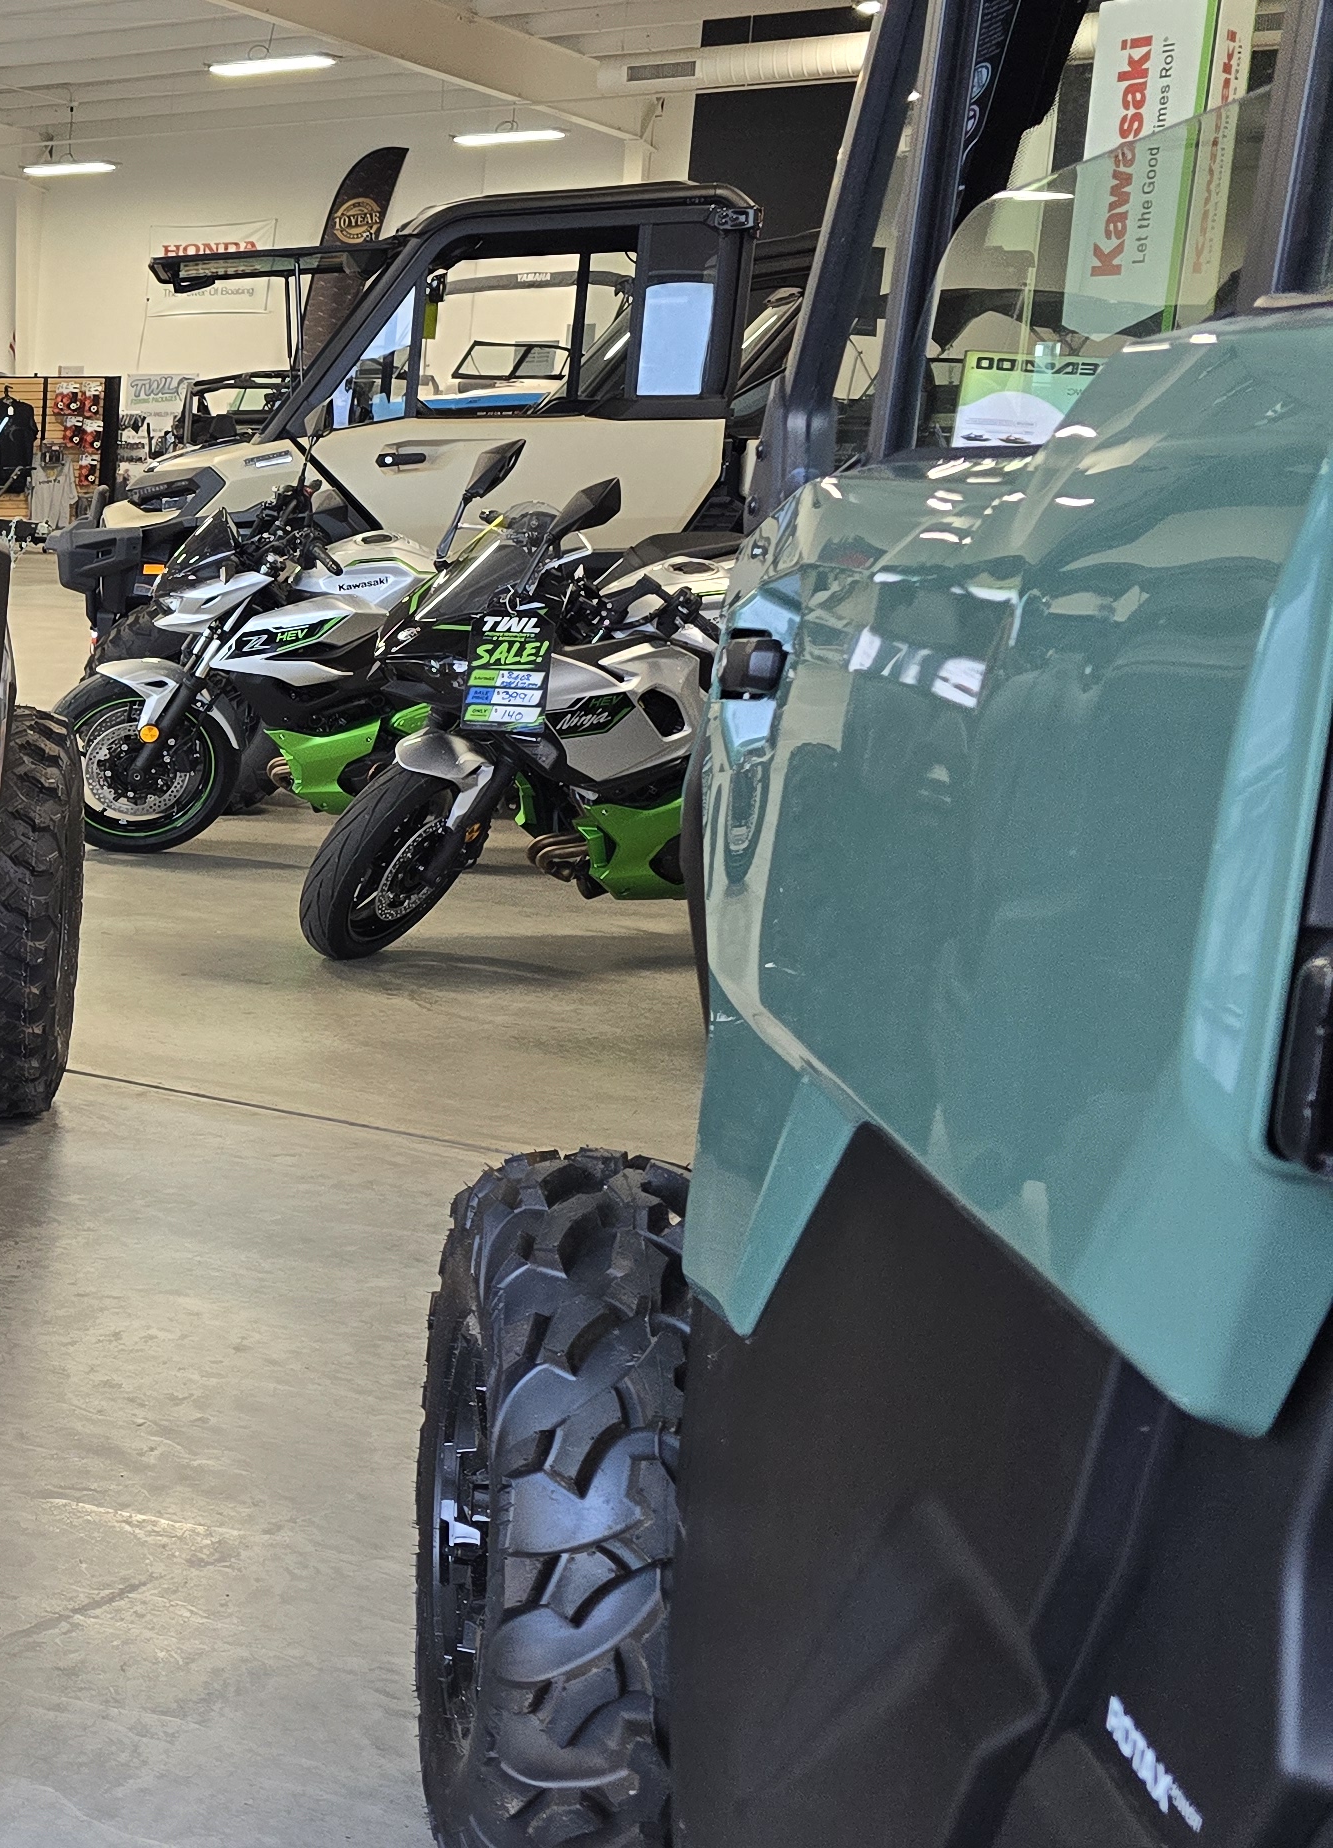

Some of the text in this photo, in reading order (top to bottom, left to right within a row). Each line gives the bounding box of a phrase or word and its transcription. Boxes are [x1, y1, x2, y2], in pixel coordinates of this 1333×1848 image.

[1090, 35, 1153, 277] Kawasaki
[1132, 42, 1176, 264] Let the Good imes Roll
[335, 212, 380, 229] 10 YEAR
[162, 240, 258, 257] HONDA
[517, 273, 551, 282] YAMAHA
[209, 287, 220, 296] Of
[221, 286, 255, 297] Boating
[130, 376, 178, 398] TWL
[338, 576, 390, 592] Kawasaki
[482, 616, 540, 633] TWL
[276, 629, 308, 643] HEV
[471, 641, 549, 667] SALE!
[589, 694, 623, 708] HEV
[501, 709, 524, 721] 140
[555, 708, 612, 732] Ninja
